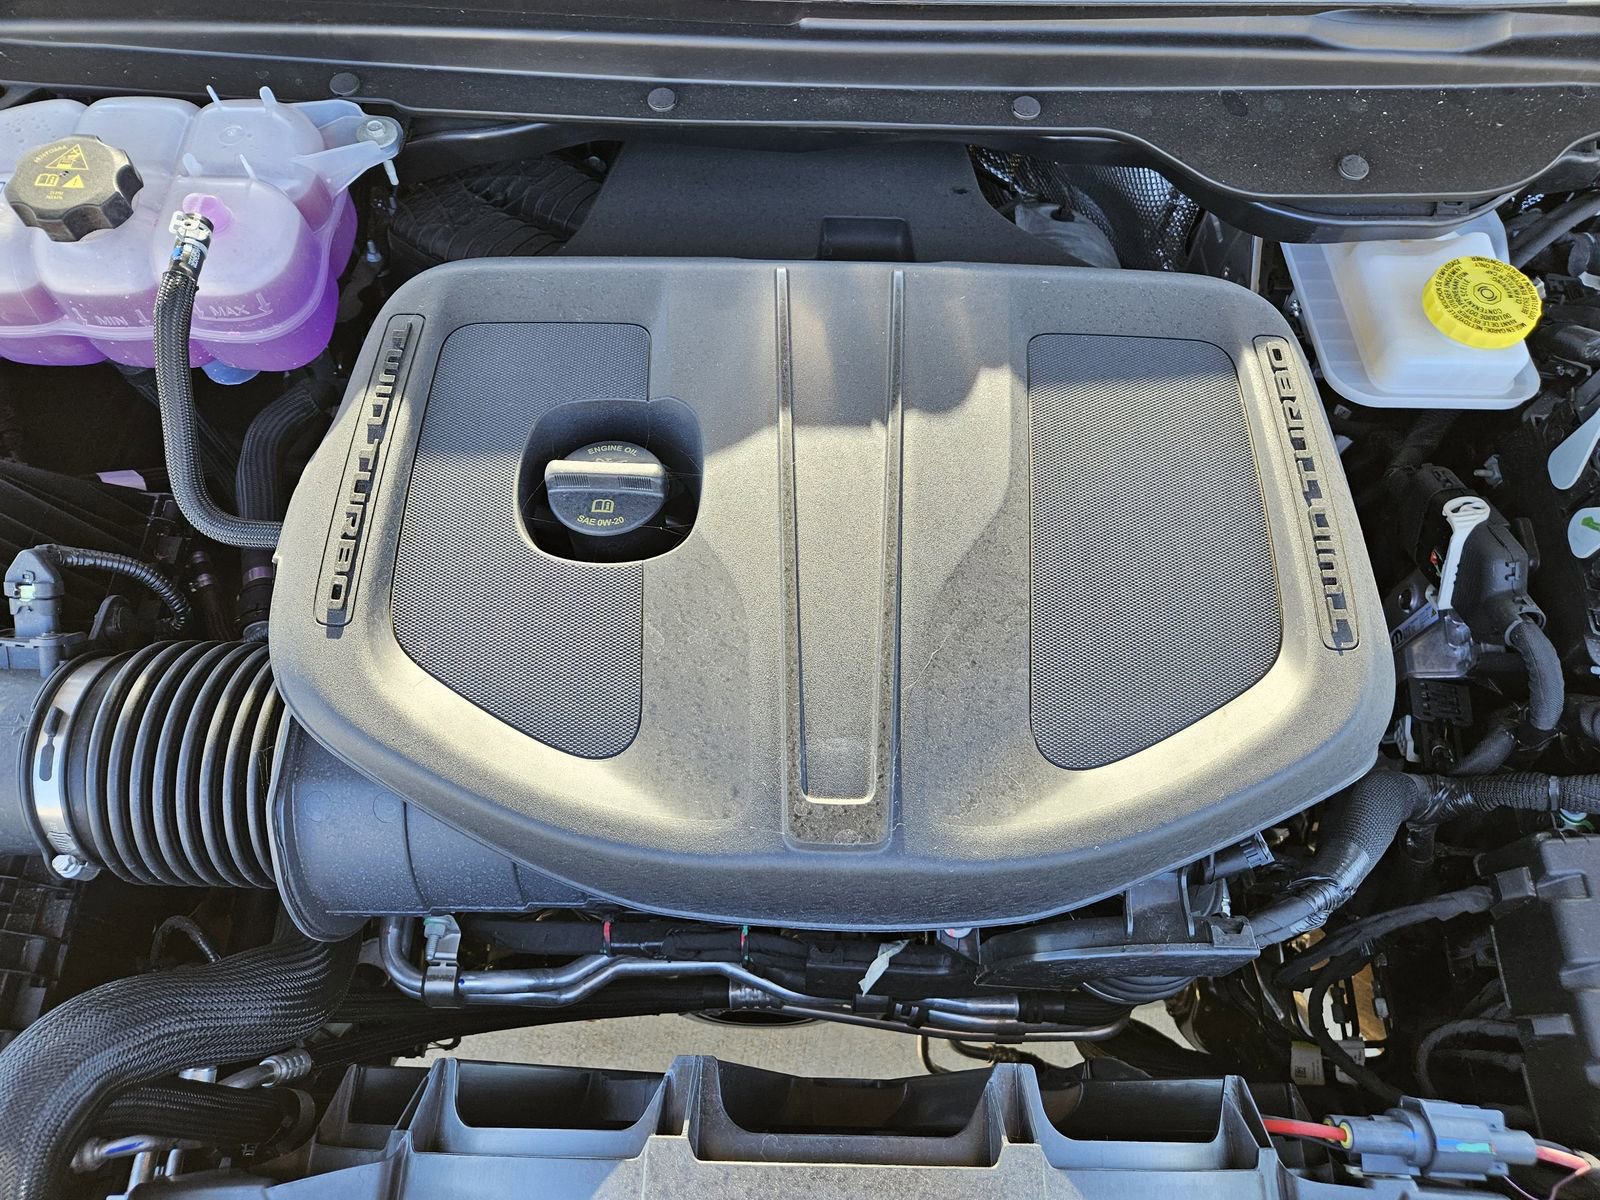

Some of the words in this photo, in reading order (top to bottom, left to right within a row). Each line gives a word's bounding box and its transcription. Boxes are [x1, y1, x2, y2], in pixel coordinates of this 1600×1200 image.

[209, 305, 250, 317] MAX
[95, 315, 129, 326] MIN
[1266, 342, 1316, 493] TURBO
[587, 445, 623, 455] ENGINE
[624, 447, 638, 457] OIL
[327, 438, 380, 611] TURBO
[577, 515, 595, 526] SAE
[597, 516, 625, 527] 0W-20
[1308, 498, 1349, 634] TWIN
